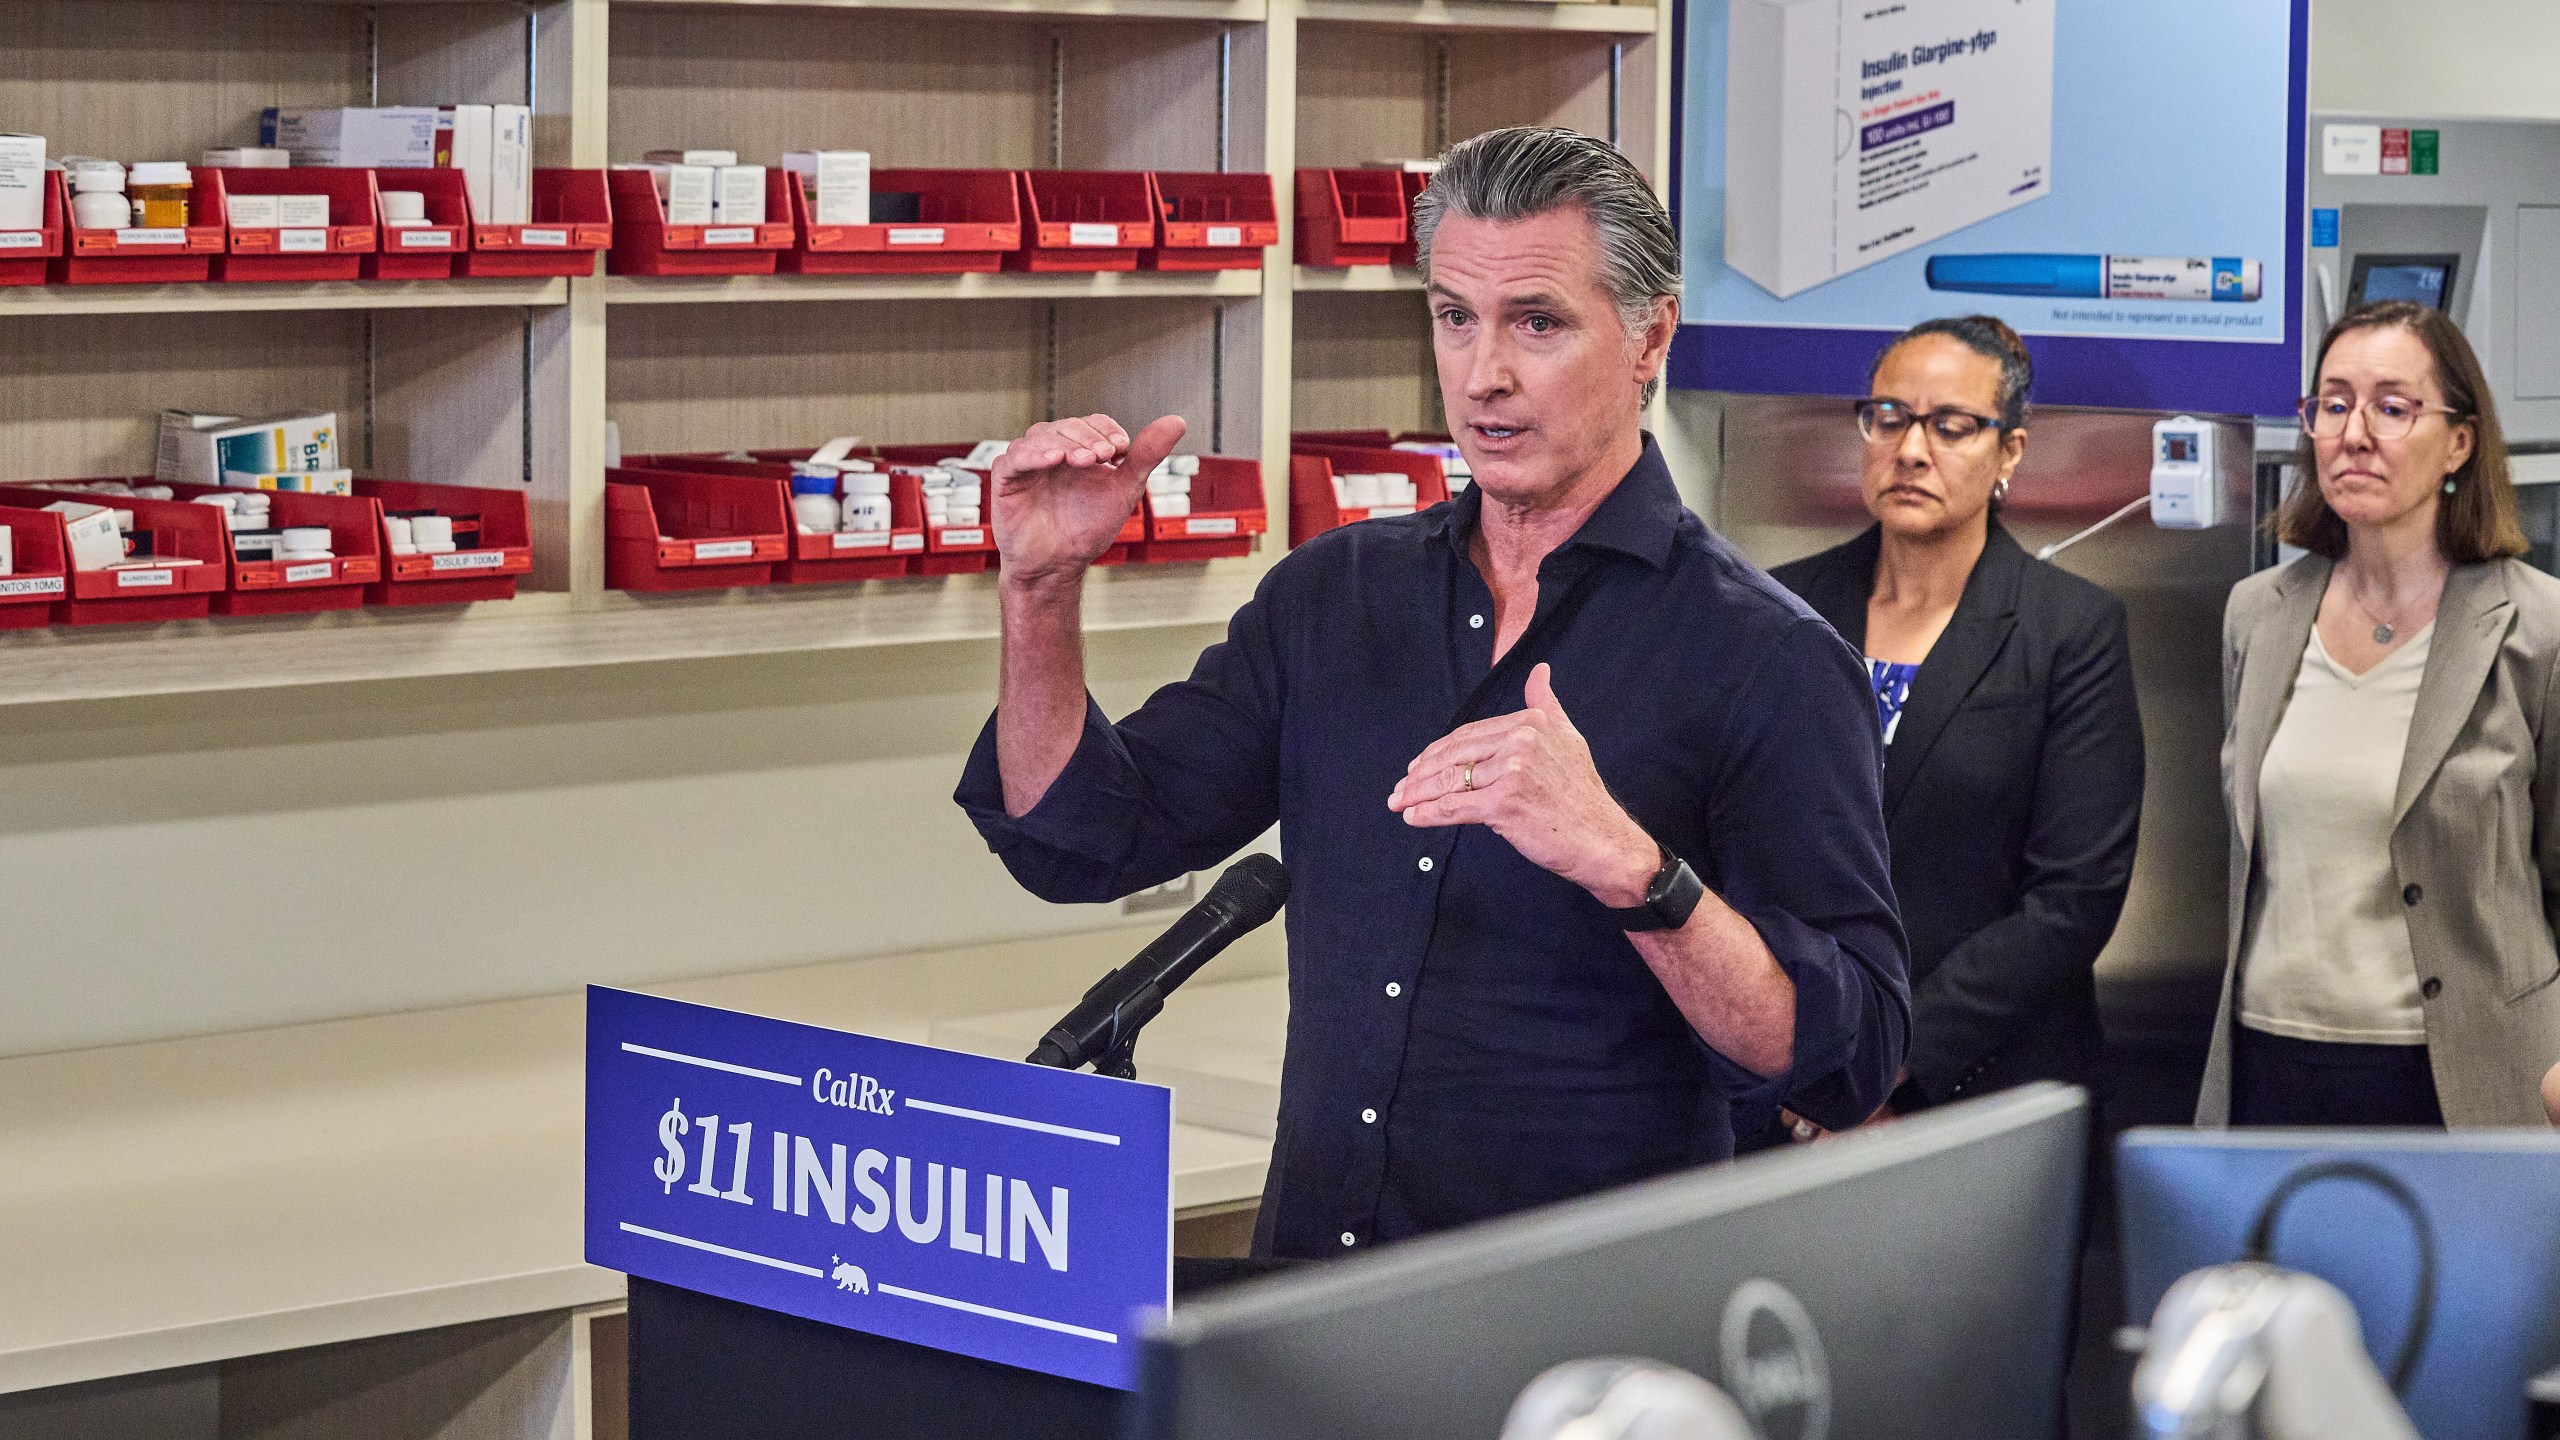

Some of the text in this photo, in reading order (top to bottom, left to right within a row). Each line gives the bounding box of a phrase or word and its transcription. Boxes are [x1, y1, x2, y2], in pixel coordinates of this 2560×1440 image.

[1861, 51, 1908, 79] Insulin
[1861, 79, 1903, 101] Injection
[2071, 310, 2113, 322] intended
[2129, 312, 2173, 324] represent
[2191, 313, 2222, 325] actual
[2224, 314, 2264, 327] product
[35, 579, 62, 590] 10MG
[812, 1067, 895, 1116] CalRx
[653, 1097, 1069, 1272] $11 INSULIN
